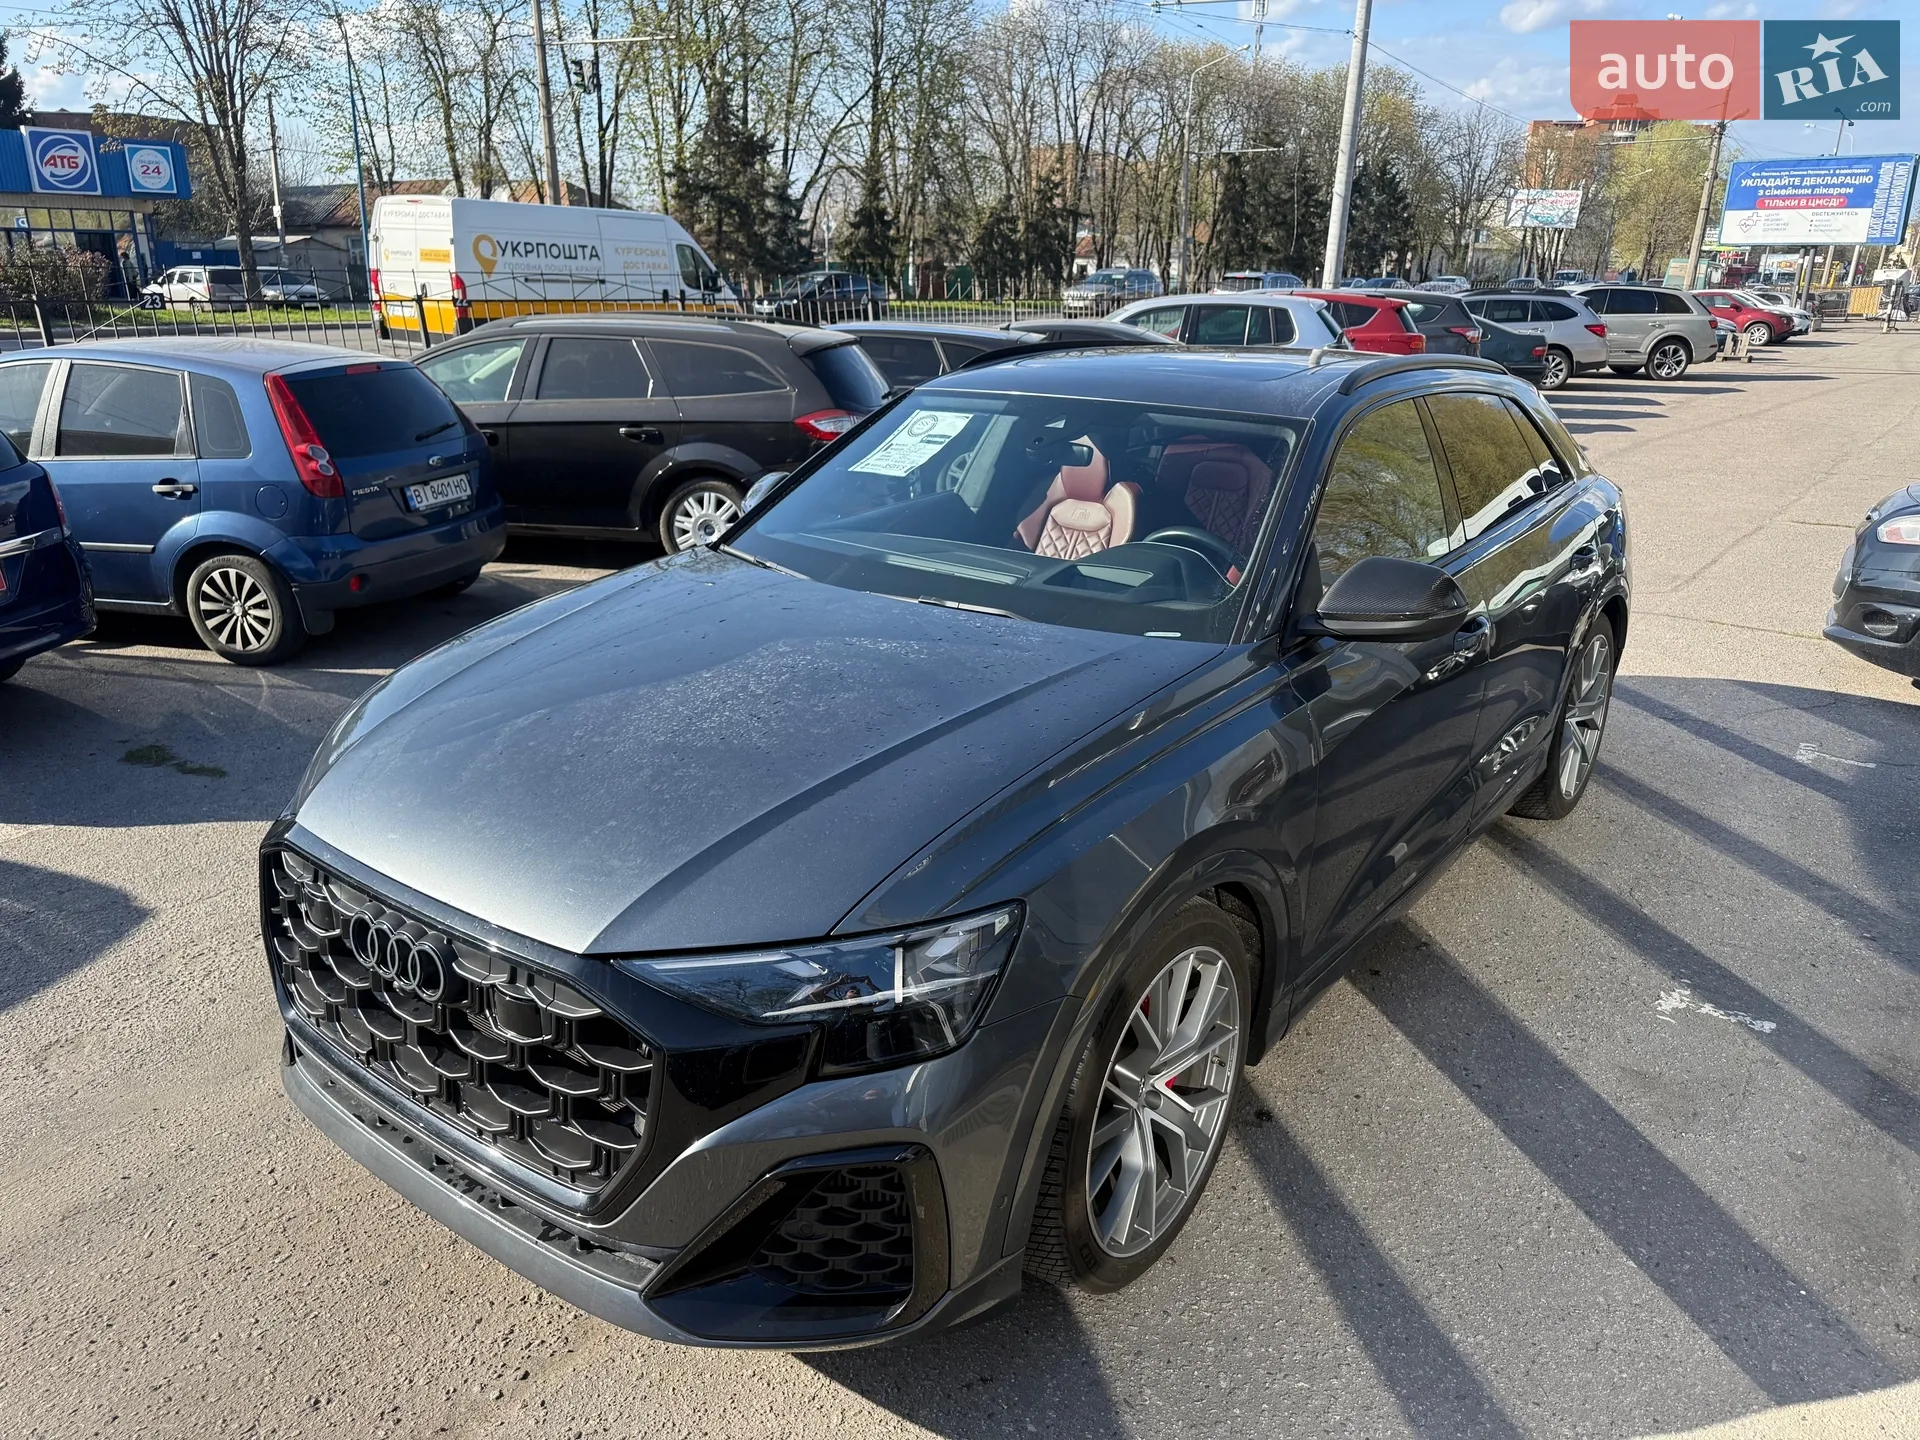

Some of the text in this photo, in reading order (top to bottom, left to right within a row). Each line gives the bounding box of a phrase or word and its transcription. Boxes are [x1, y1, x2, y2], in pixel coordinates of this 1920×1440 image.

[43, 155, 79, 169] АТБ
[140, 164, 162, 176] 24
[1741, 175, 1874, 187] УКЛАДАЙТЕ ДЕКЛАРАЦІЮ
[1766, 187, 1812, 196] сімейним
[1813, 186, 1854, 196] лікарем
[1764, 198, 1800, 207] ТІЛЬКИ
[496, 240, 601, 261] УКРПОШТА
[503, 262, 541, 271] ГОЛОВНА
[622, 260, 669, 270] ДОСТАВКА
[144, 295, 162, 309] 23
[705, 294, 714, 305] 21
[352, 486, 379, 496] FIESTA
[431, 482, 455, 500] 8401
